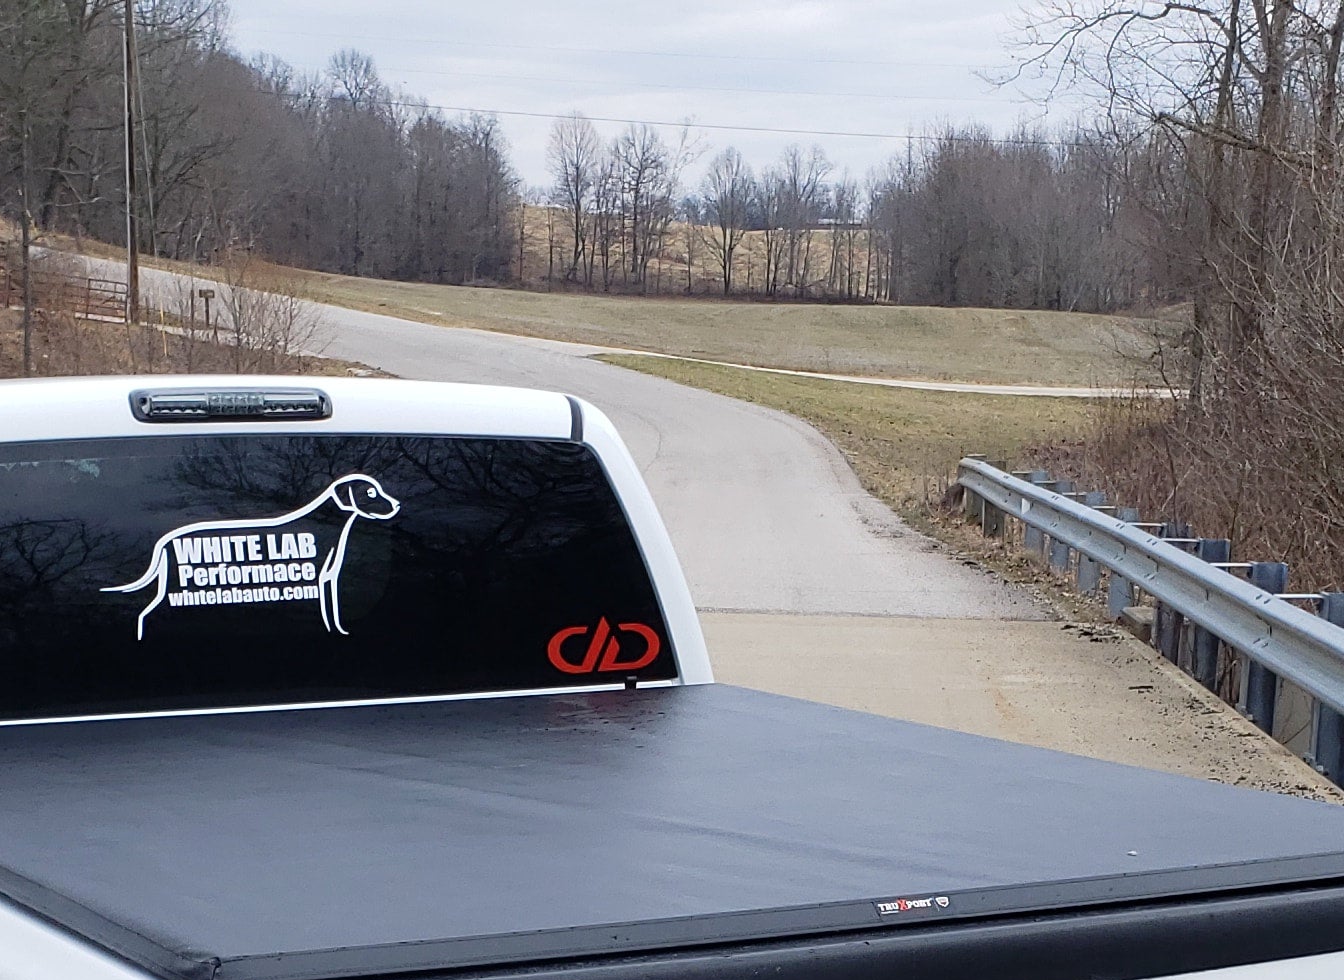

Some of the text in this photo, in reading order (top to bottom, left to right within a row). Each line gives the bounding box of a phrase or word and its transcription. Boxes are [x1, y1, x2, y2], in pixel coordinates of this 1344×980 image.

[172, 532, 317, 564] WHITE LAB
[178, 562, 316, 587] Performace
[168, 586, 319, 606] whitelabauto.com
